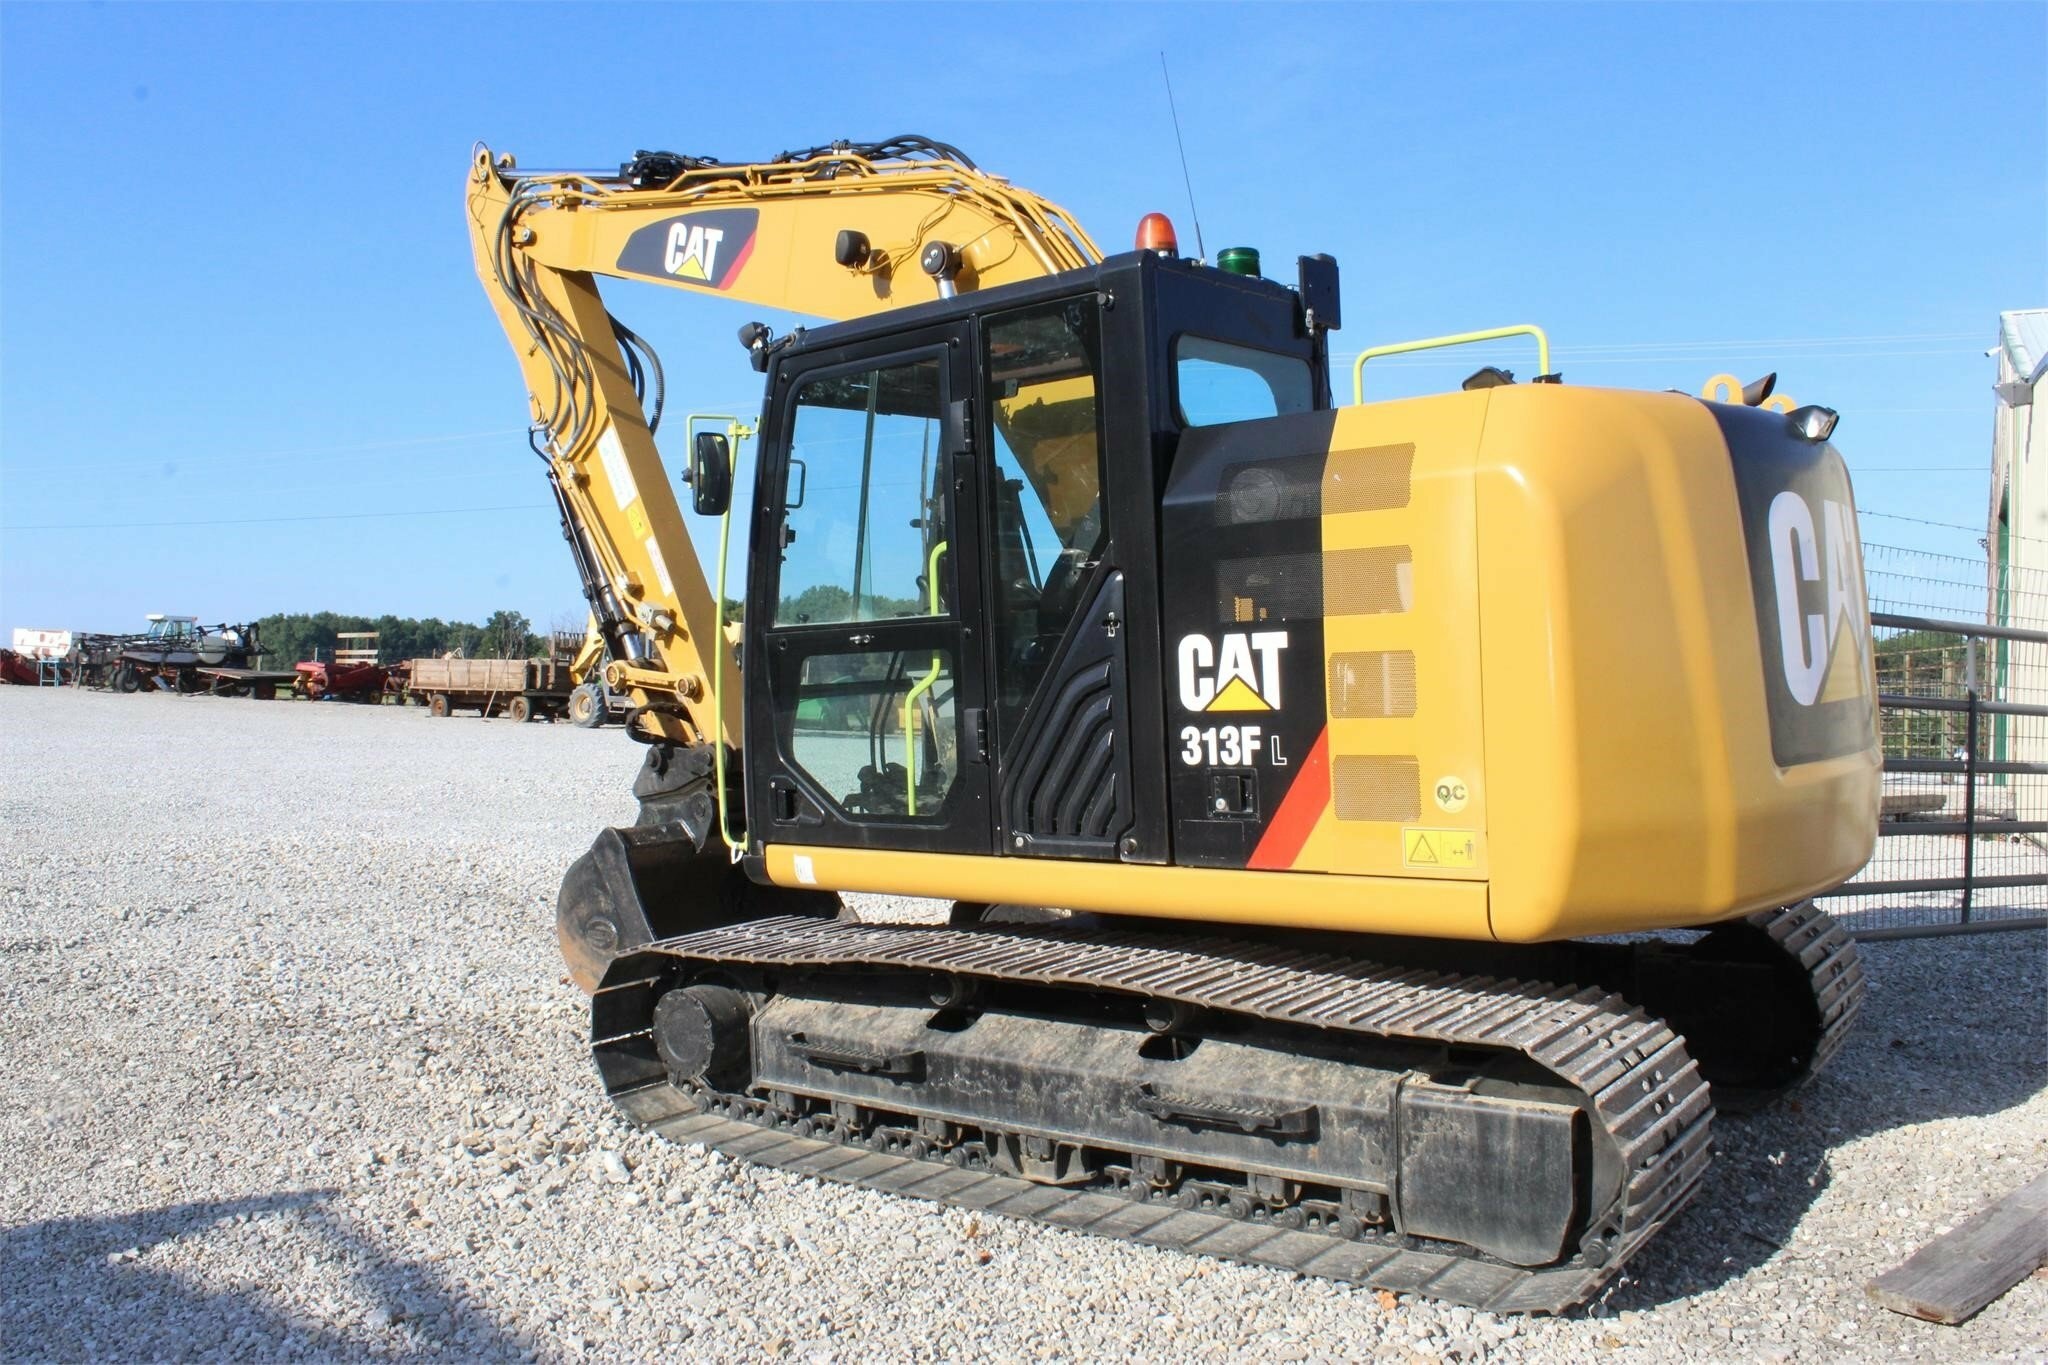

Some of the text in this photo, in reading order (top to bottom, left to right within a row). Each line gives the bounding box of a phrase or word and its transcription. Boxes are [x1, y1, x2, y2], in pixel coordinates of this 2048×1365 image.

[664, 222, 724, 281] CAT
[1178, 631, 1288, 711] CAT
[1180, 725, 1288, 766] 313F L
[1436, 784, 1466, 804] QC
